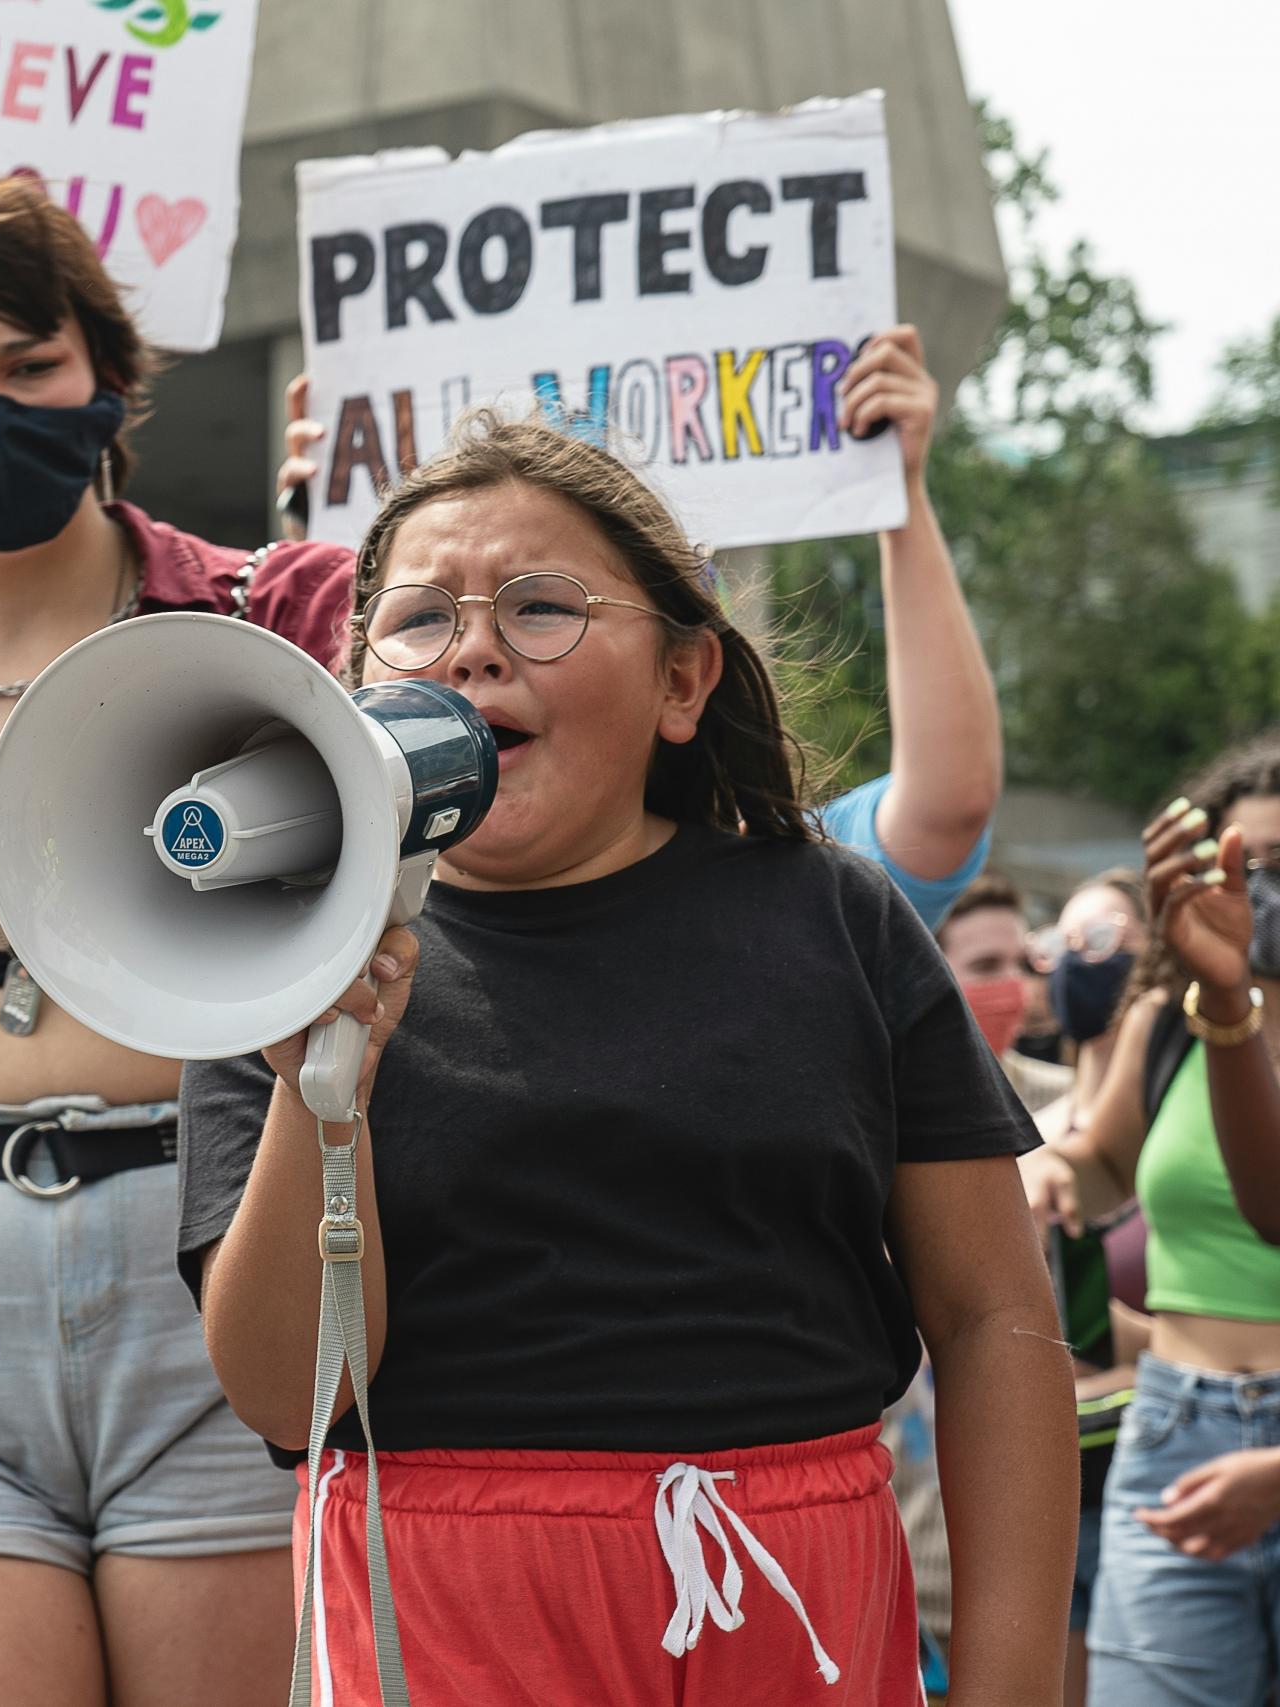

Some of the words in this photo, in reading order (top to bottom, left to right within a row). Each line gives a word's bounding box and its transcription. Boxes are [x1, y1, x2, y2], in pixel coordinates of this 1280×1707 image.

[311, 170, 867, 344] PROTECT
[532, 333, 888, 465] WORKER
[177, 852, 209, 861] MEGA2
[179, 837, 205, 850] APEX
